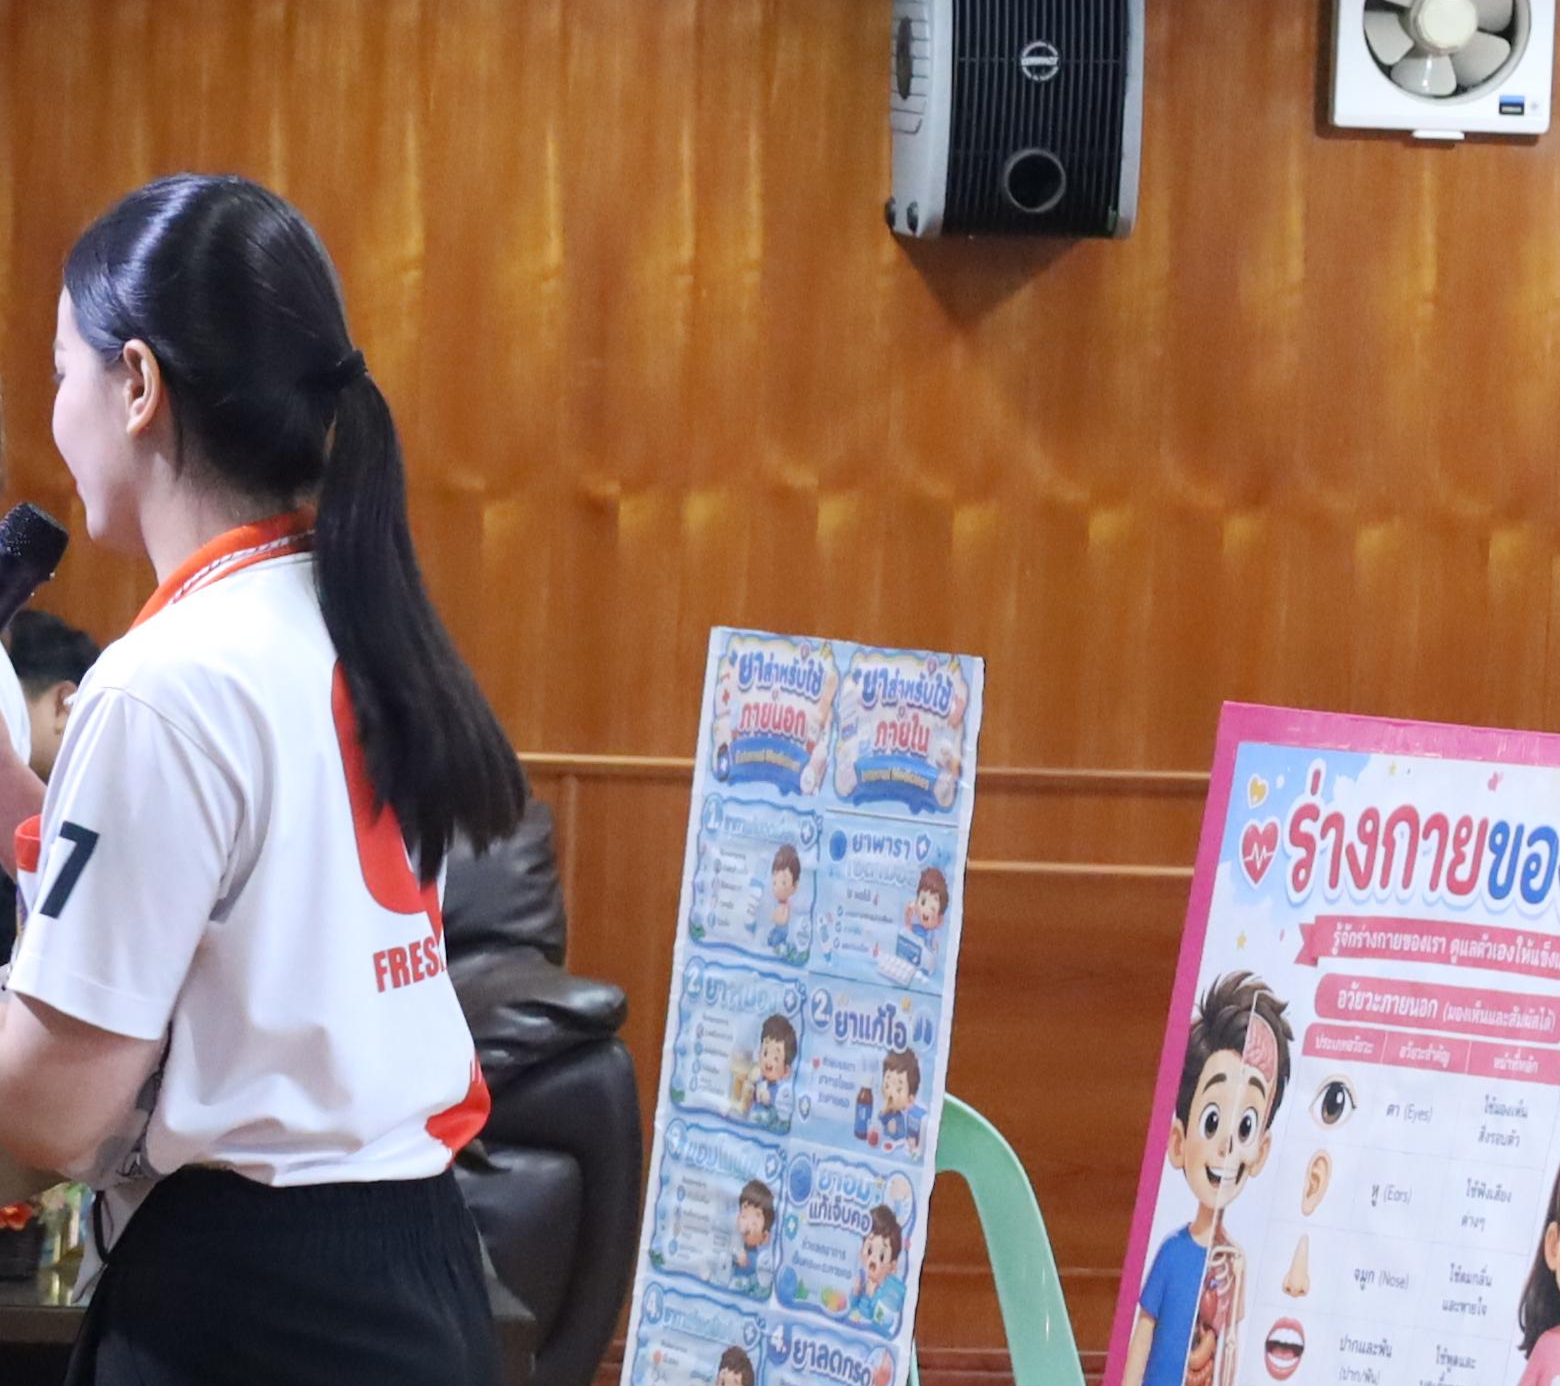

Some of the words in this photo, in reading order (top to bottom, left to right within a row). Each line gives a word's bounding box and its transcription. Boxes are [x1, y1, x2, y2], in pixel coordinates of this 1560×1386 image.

[739, 652, 824, 696] ยาสำหรับใช้
[861, 668, 954, 713] ยาสำหรับใช้
[741, 700, 807, 737] ภายนอก
[875, 715, 930, 752] ภายใน
[853, 834, 911, 861] ยาพารา
[1333, 923, 1447, 955] รู้จักร่างกายของเรา
[373, 936, 444, 993] FRES
[1337, 981, 1438, 1018] อวัยวะภายนอก
[1442, 999, 1556, 1033] (มองเห็นและสัมผัสได้)
[835, 1004, 907, 1049] ยาแก้ไอ
[1386, 1103, 1401, 1118] ตา
[1404, 1104, 1432, 1123] (Eyes)
[819, 1171, 872, 1201] ยาอม
[1371, 1185, 1380, 1207] หู
[1383, 1186, 1412, 1206] (Ears)
[809, 1195, 870, 1233] แก้เจ็บคอ
[1354, 1267, 1375, 1291] จมูก
[1378, 1268, 1409, 1290] (Nose)
